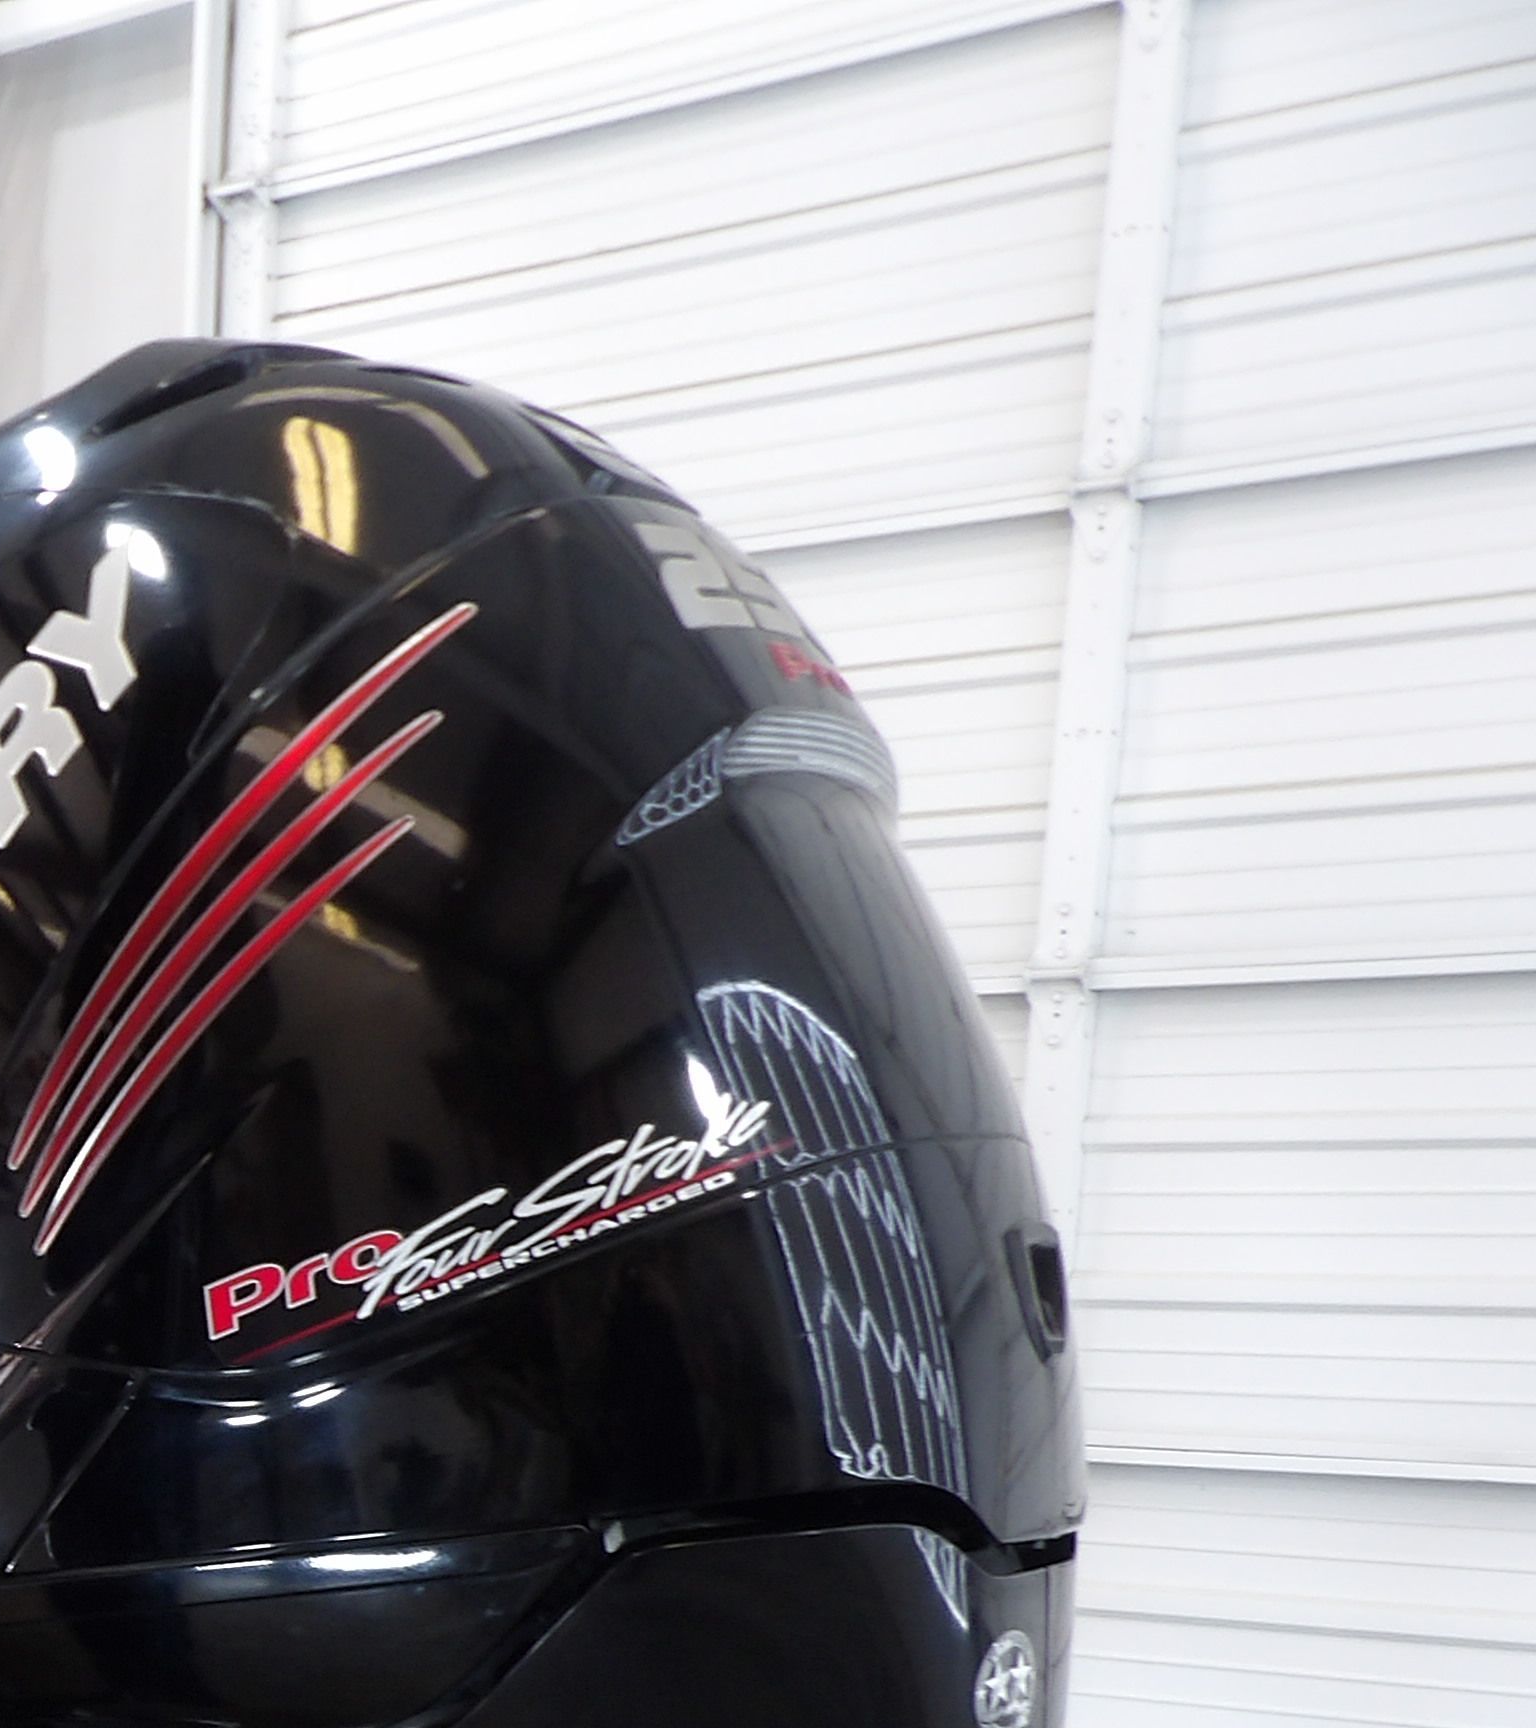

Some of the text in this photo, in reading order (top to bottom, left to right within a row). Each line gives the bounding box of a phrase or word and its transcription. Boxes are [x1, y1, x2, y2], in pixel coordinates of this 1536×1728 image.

[203, 1230, 405, 1341] Pro
[356, 1187, 518, 1320] Four
[396, 1169, 738, 1314] SUPERCHARGED
